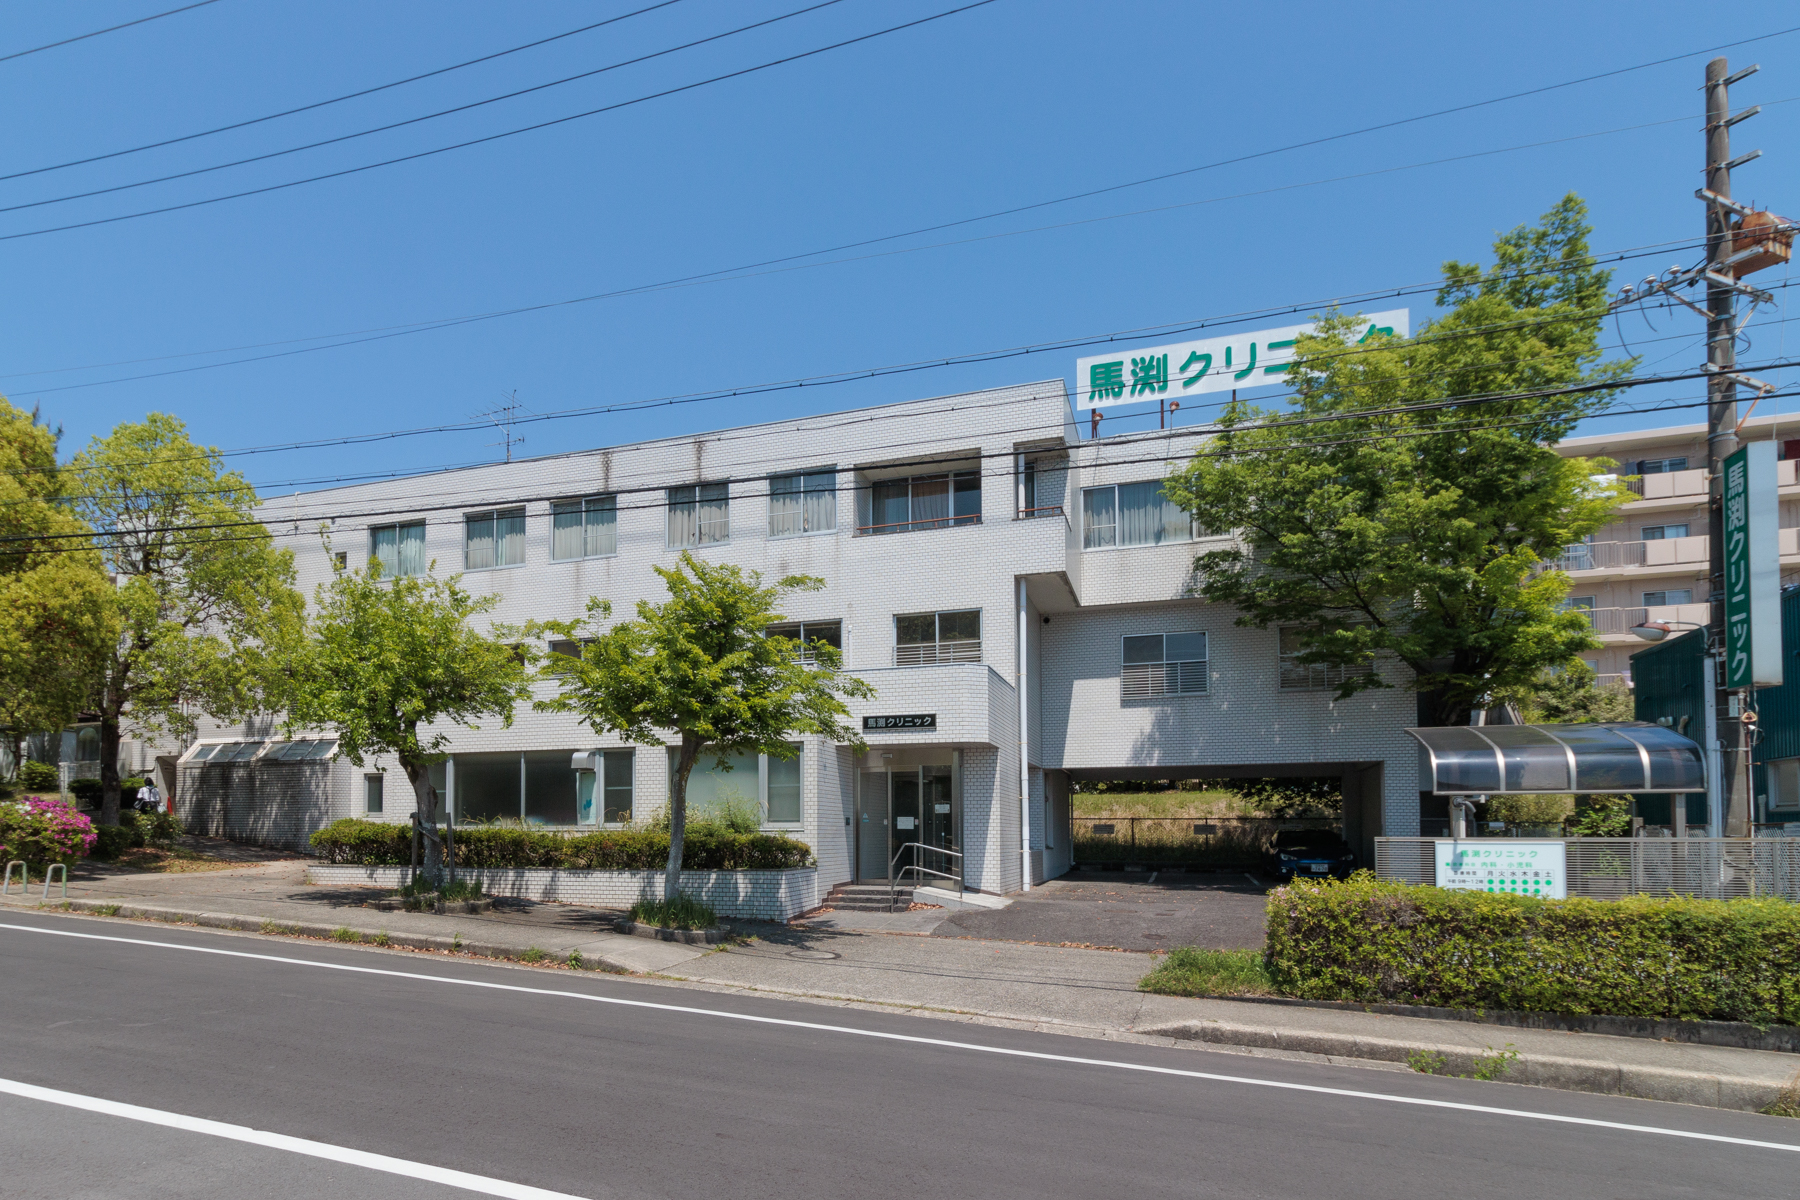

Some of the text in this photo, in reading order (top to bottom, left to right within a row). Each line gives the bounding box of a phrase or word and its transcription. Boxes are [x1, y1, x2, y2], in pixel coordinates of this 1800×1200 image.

[1088, 322, 1395, 401] 馬渕クリニク
[1727, 460, 1748, 682] 馬渕クリニック
[867, 716, 932, 728] 馬渕クリニック
[1533, 870, 1540, 878] 金
